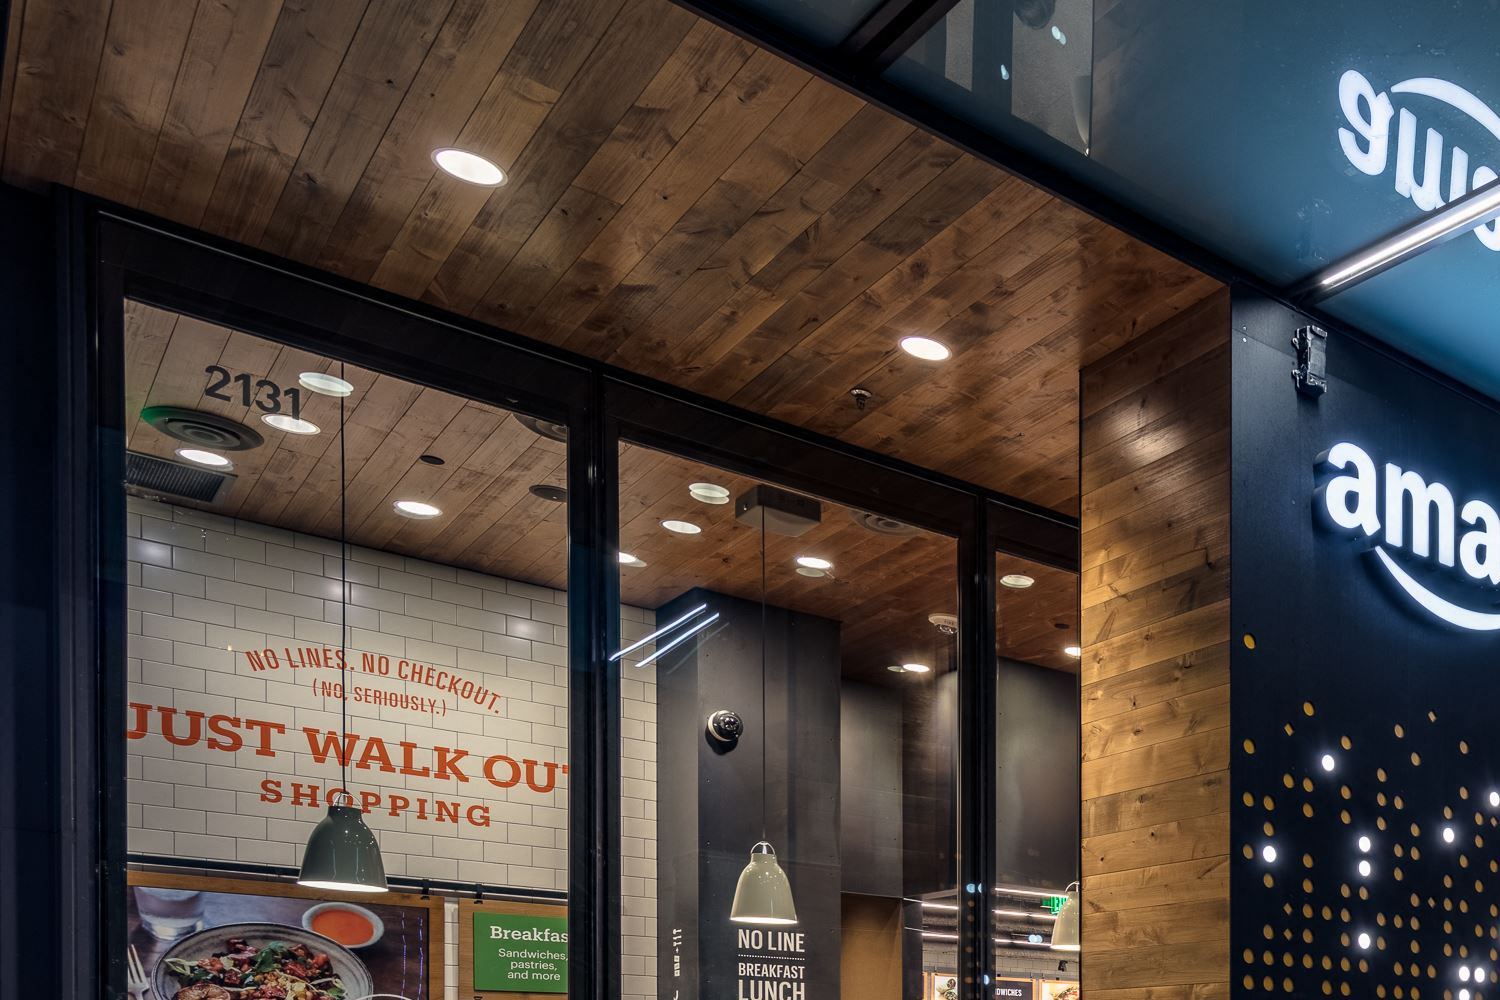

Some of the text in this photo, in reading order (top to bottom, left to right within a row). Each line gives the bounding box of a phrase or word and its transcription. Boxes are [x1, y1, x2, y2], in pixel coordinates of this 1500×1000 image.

[205, 365, 300, 420] 2131
[245, 647, 502, 714] NO LINES. NO CHECKOUT.
[354, 687, 447, 716] SERIOUSLY.)
[127, 702, 569, 793] JUST WALK OU
[260, 779, 490, 827] SHOPPING
[490, 925, 568, 943] Breakfas
[738, 928, 805, 953] NO LINE
[498, 948, 568, 961] Sandwiches,
[507, 970, 561, 981] and more
[511, 960, 558, 971] pastries,
[738, 962, 805, 979] BREAKFAST
[995, 988, 1023, 997] DWICHES
